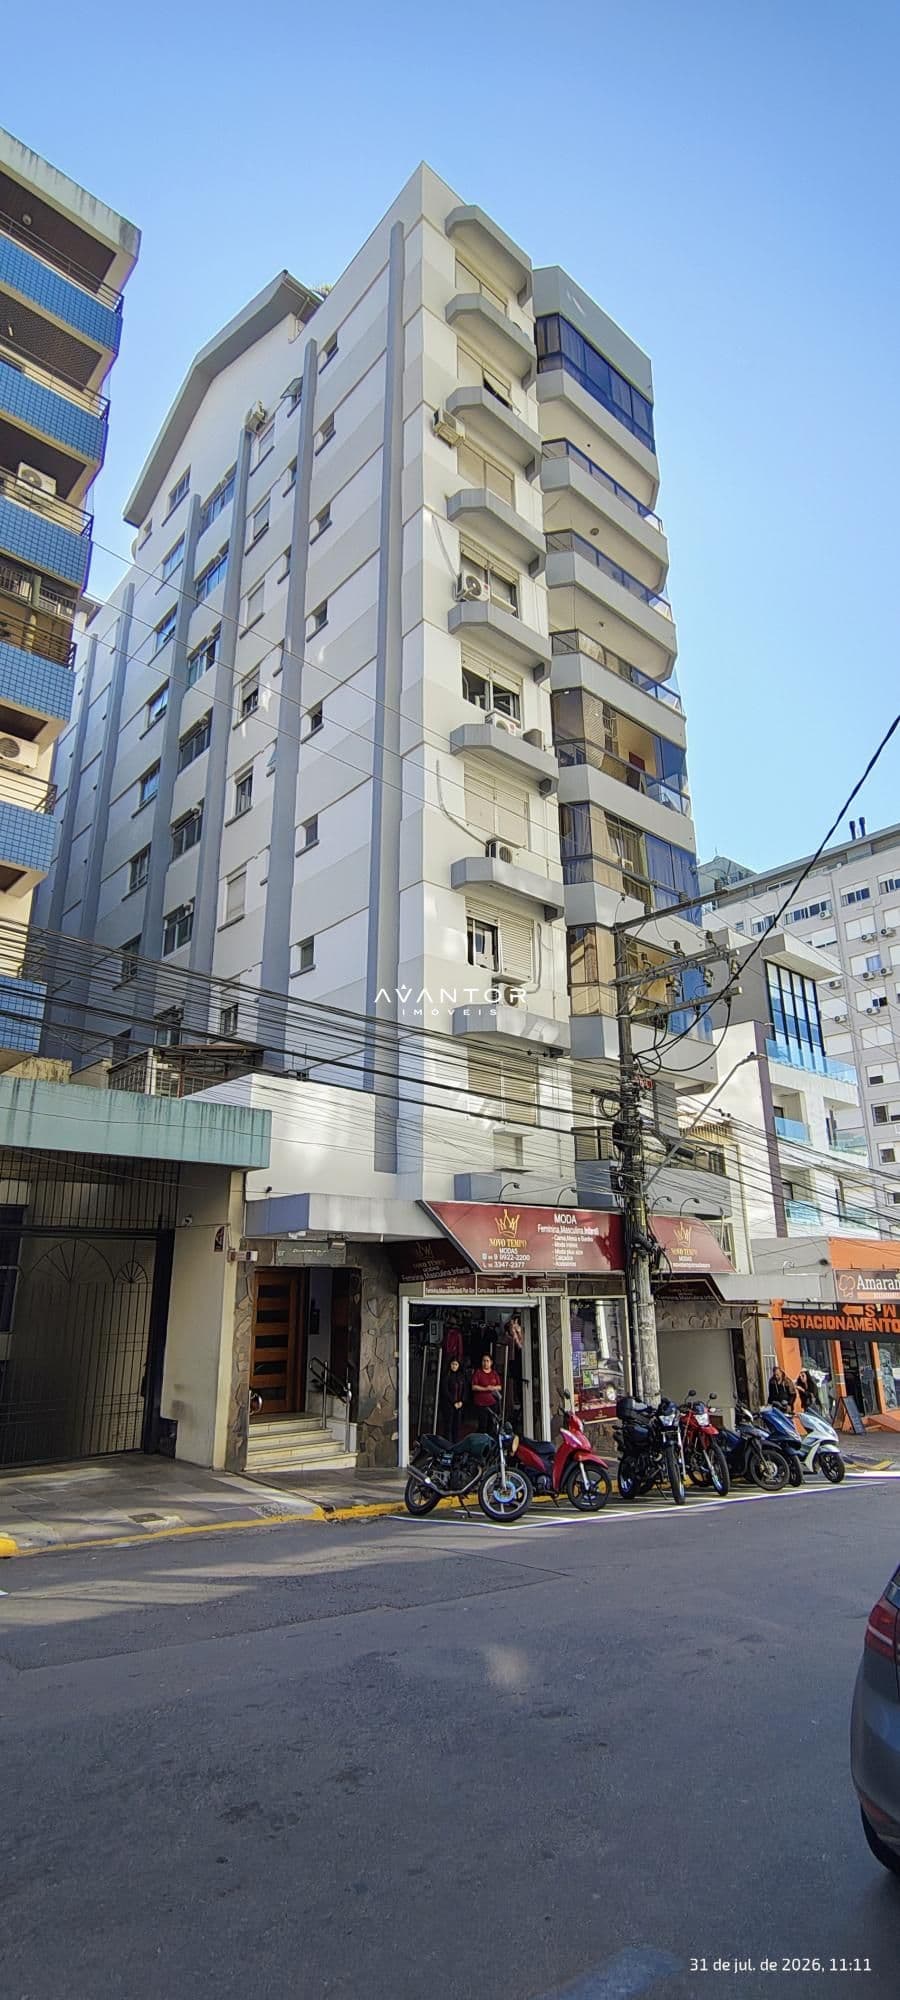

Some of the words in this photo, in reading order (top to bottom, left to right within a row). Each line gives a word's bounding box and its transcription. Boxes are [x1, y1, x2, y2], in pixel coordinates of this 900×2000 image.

[554, 1212, 577, 1225] MODA
[489, 1237, 506, 1247] NOVO
[507, 1238, 528, 1248] TEMPO
[499, 1247, 519, 1255] MODAS
[783, 1314, 900, 1334] ESTACIONAMENTO
